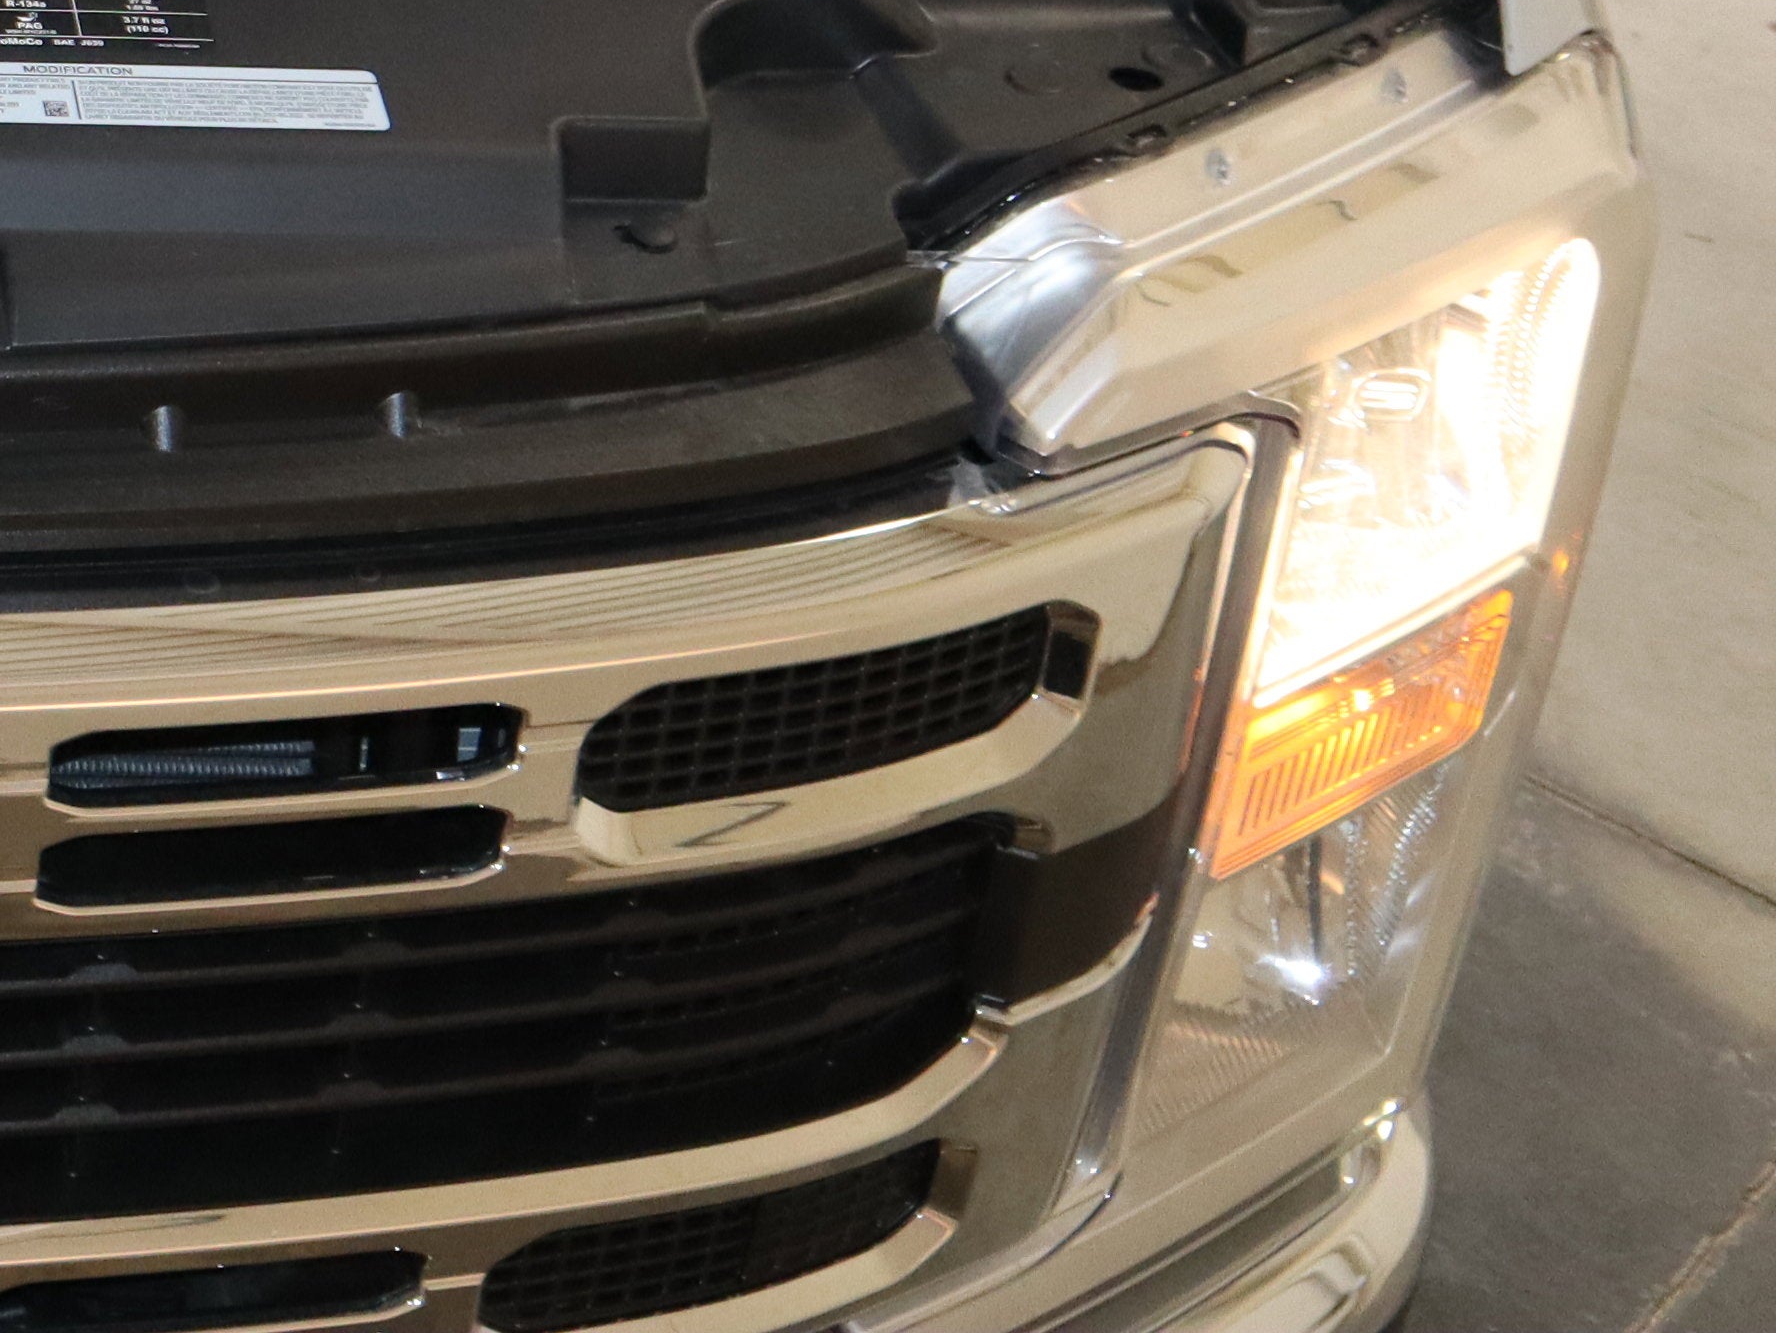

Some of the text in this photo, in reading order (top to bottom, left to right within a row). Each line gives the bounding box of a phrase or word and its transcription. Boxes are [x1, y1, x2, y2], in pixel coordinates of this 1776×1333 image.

[5, 0, 47, 8] R-134a
[122, 16, 138, 24] 3.7
[17, 22, 43, 30] PAG
[53, 38, 76, 46] SAE
[23, 65, 133, 76] MODIFICATION
